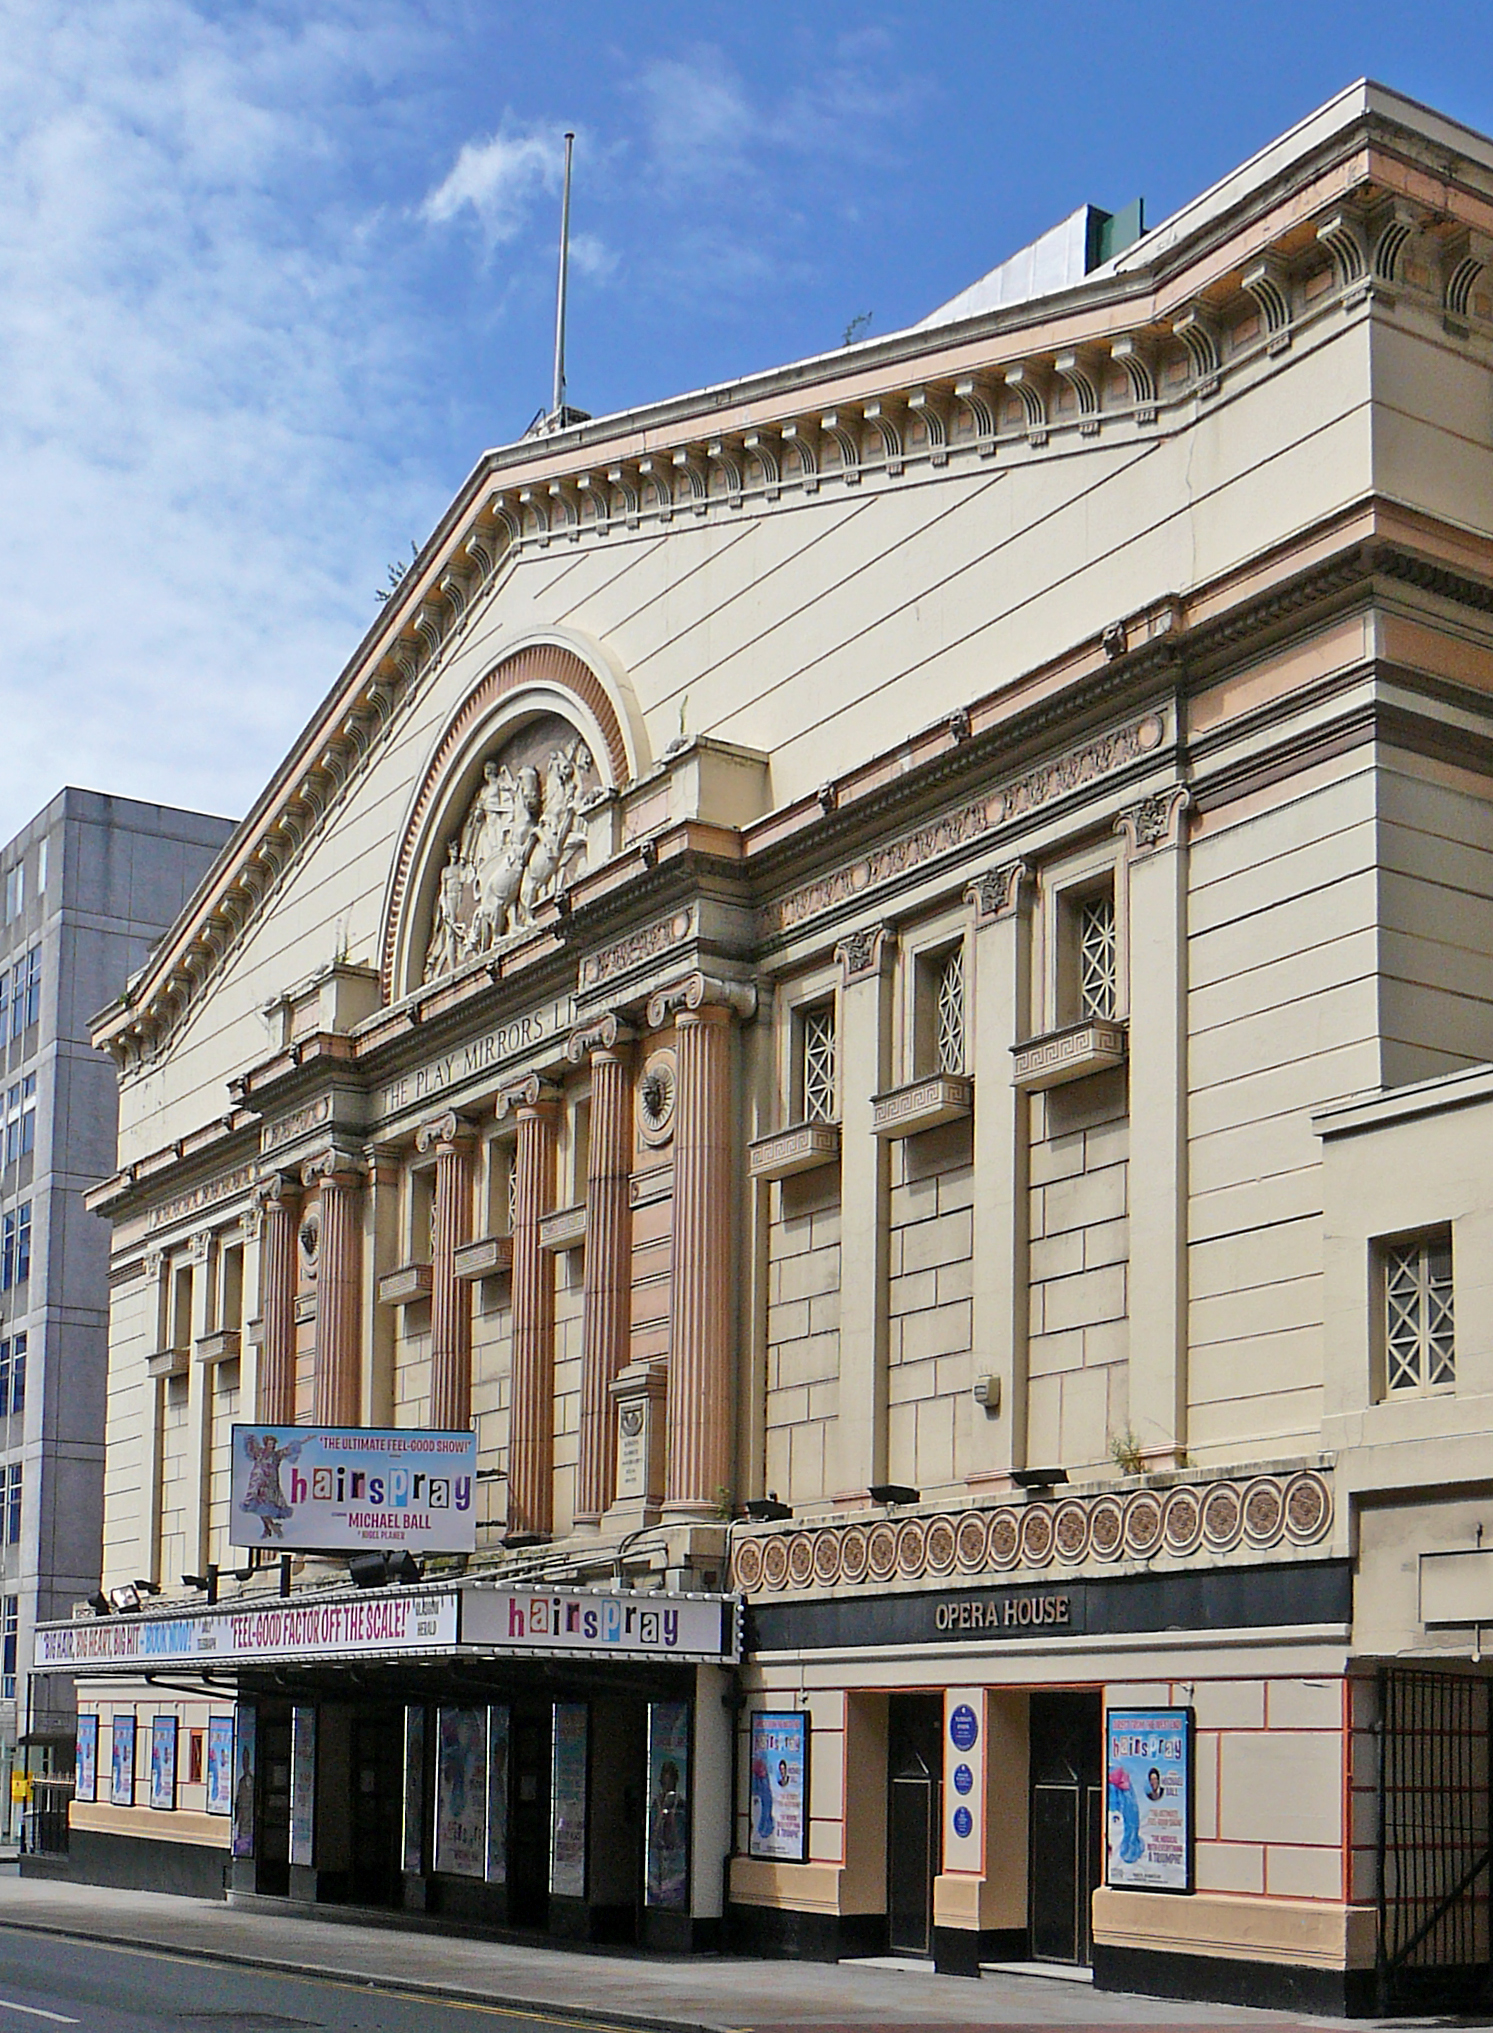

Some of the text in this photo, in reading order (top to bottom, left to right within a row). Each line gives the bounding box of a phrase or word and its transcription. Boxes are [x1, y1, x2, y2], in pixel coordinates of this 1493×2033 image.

[382, 1077, 408, 1114] THE
[416, 1054, 455, 1098] PLAY
[463, 1010, 544, 1077] MIRRORS
[342, 1436, 385, 1451] ULTIMATE
[387, 1438, 434, 1452] FEEL-GOOD
[290, 1466, 471, 1511] hairspray
[348, 1512, 432, 1530] MICHAEL BALL
[283, 1610, 320, 1647] FACTOR
[321, 1607, 342, 1643] OFF
[343, 1606, 363, 1641] THE
[508, 1597, 679, 1647] hairspray
[935, 1595, 1069, 1630] OPERA HOUSE
[1112, 1735, 1182, 1760] hairspray
